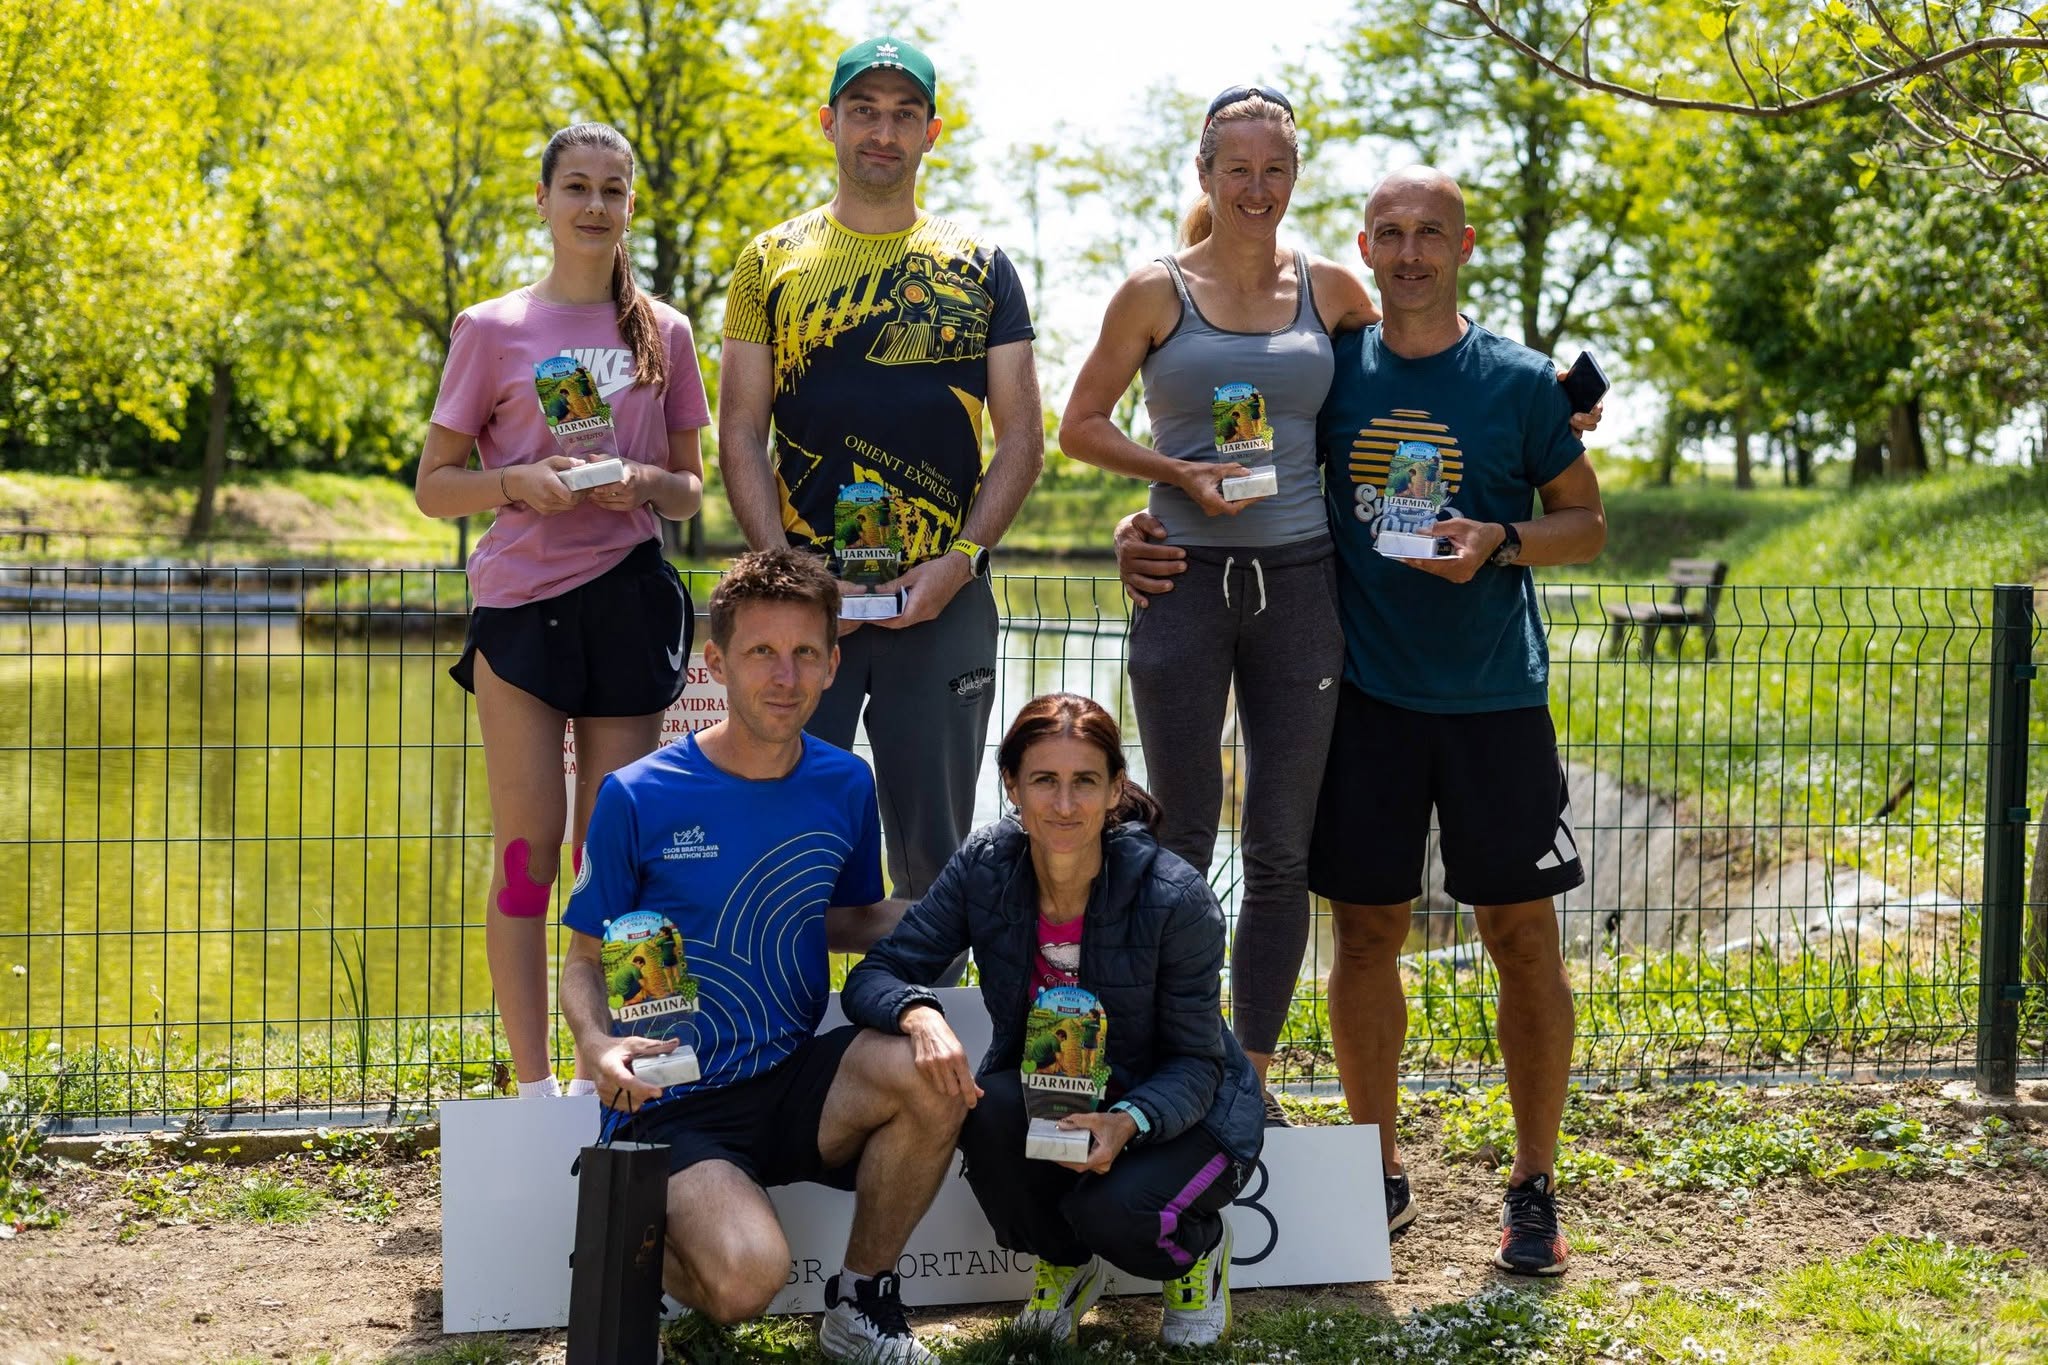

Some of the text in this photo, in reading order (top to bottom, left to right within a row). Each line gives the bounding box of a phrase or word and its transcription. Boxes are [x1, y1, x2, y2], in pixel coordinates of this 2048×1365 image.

[559, 417, 606, 434] JARMINA
[1223, 440, 1266, 453] JARMINA
[845, 435, 960, 507] ORIENT EXPRESS
[920, 460, 952, 486] Vinkovci
[1391, 497, 1434, 510] JARMINA
[843, 550, 894, 560] JARMINA
[664, 852, 701, 860] MARATHON
[623, 997, 688, 1020] JARMINA
[1031, 1076, 1096, 1092] JARMINA
